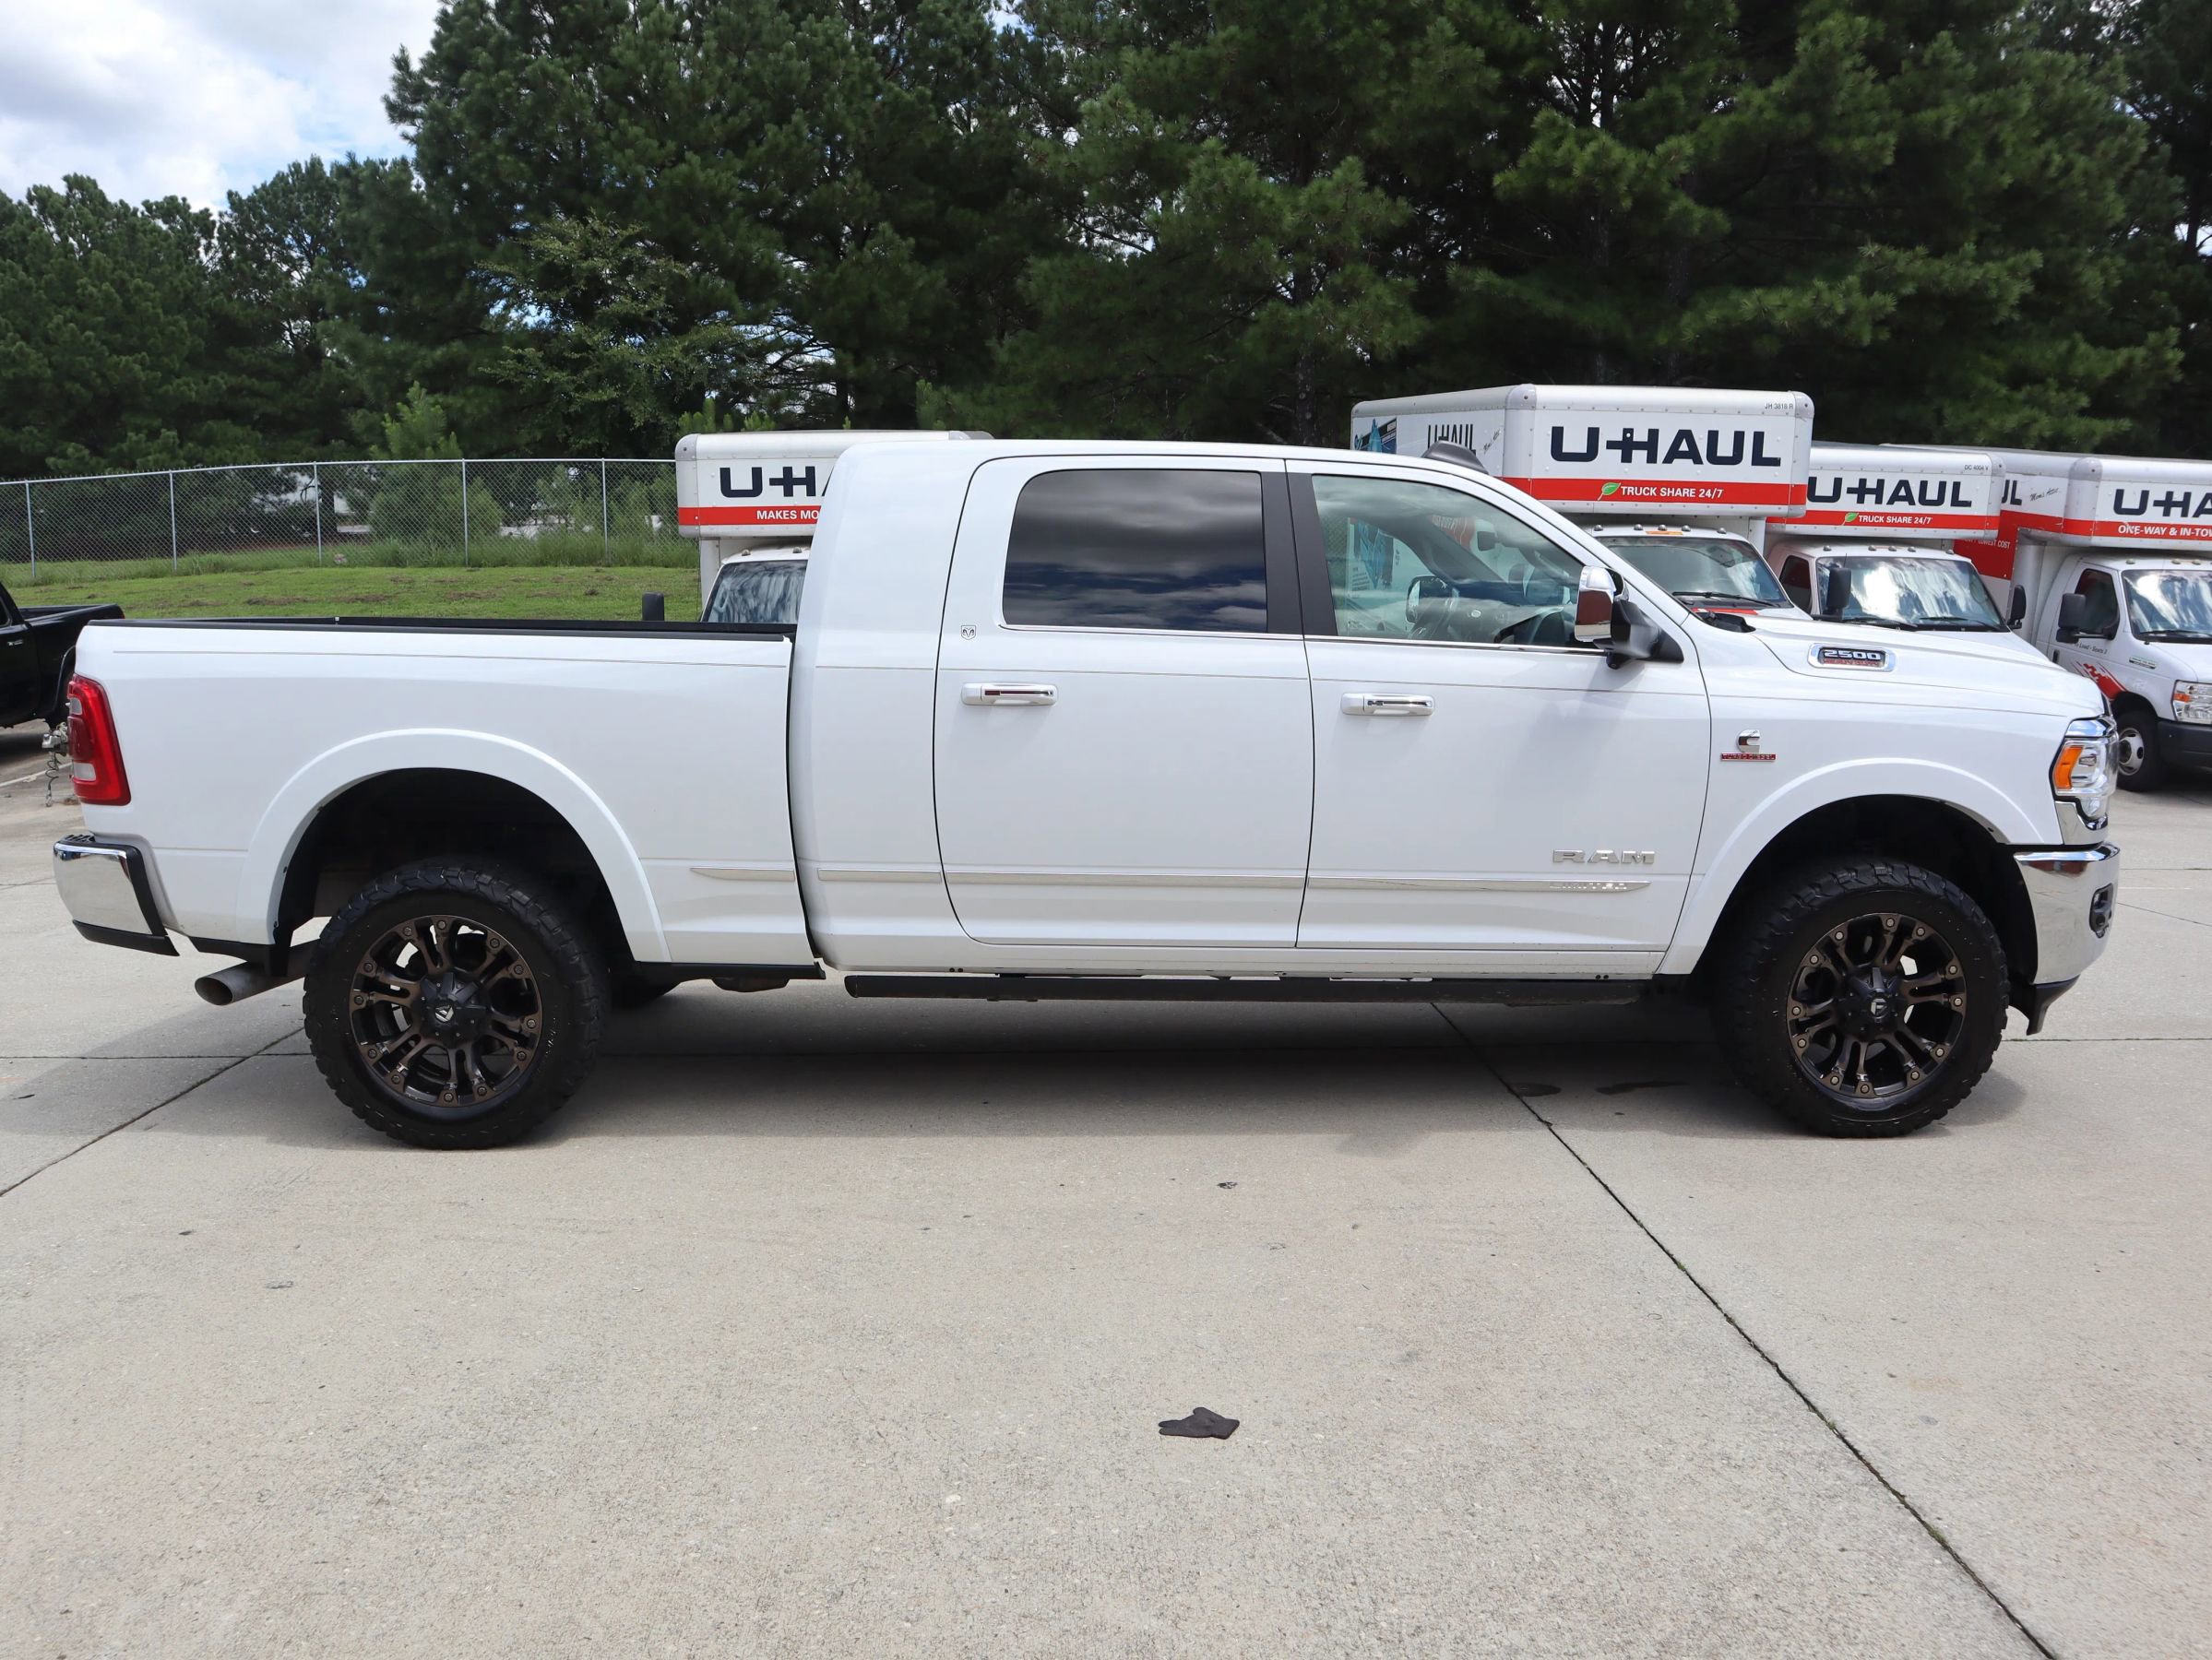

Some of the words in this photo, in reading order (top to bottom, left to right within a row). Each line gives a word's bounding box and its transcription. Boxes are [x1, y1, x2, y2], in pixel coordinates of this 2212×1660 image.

[1764, 402, 1773, 410] JH
[1551, 426, 1781, 467] U-HAUL
[719, 466, 835, 498] U-H
[1621, 485, 1658, 497] TRUCK
[1659, 487, 1697, 498] SHARE
[1698, 488, 1724, 500] 24/7
[1807, 476, 1972, 508] U-HAUL
[756, 509, 798, 521] MAKES
[1859, 514, 1885, 523] TRUCK
[1886, 515, 1912, 524] SHARE
[1914, 516, 1933, 526] 24/7
[2118, 524, 2168, 535] ONE-WAY
[2169, 526, 2178, 536] &
[1823, 649, 1882, 660] 2500
[1552, 848, 1656, 864] RAM
